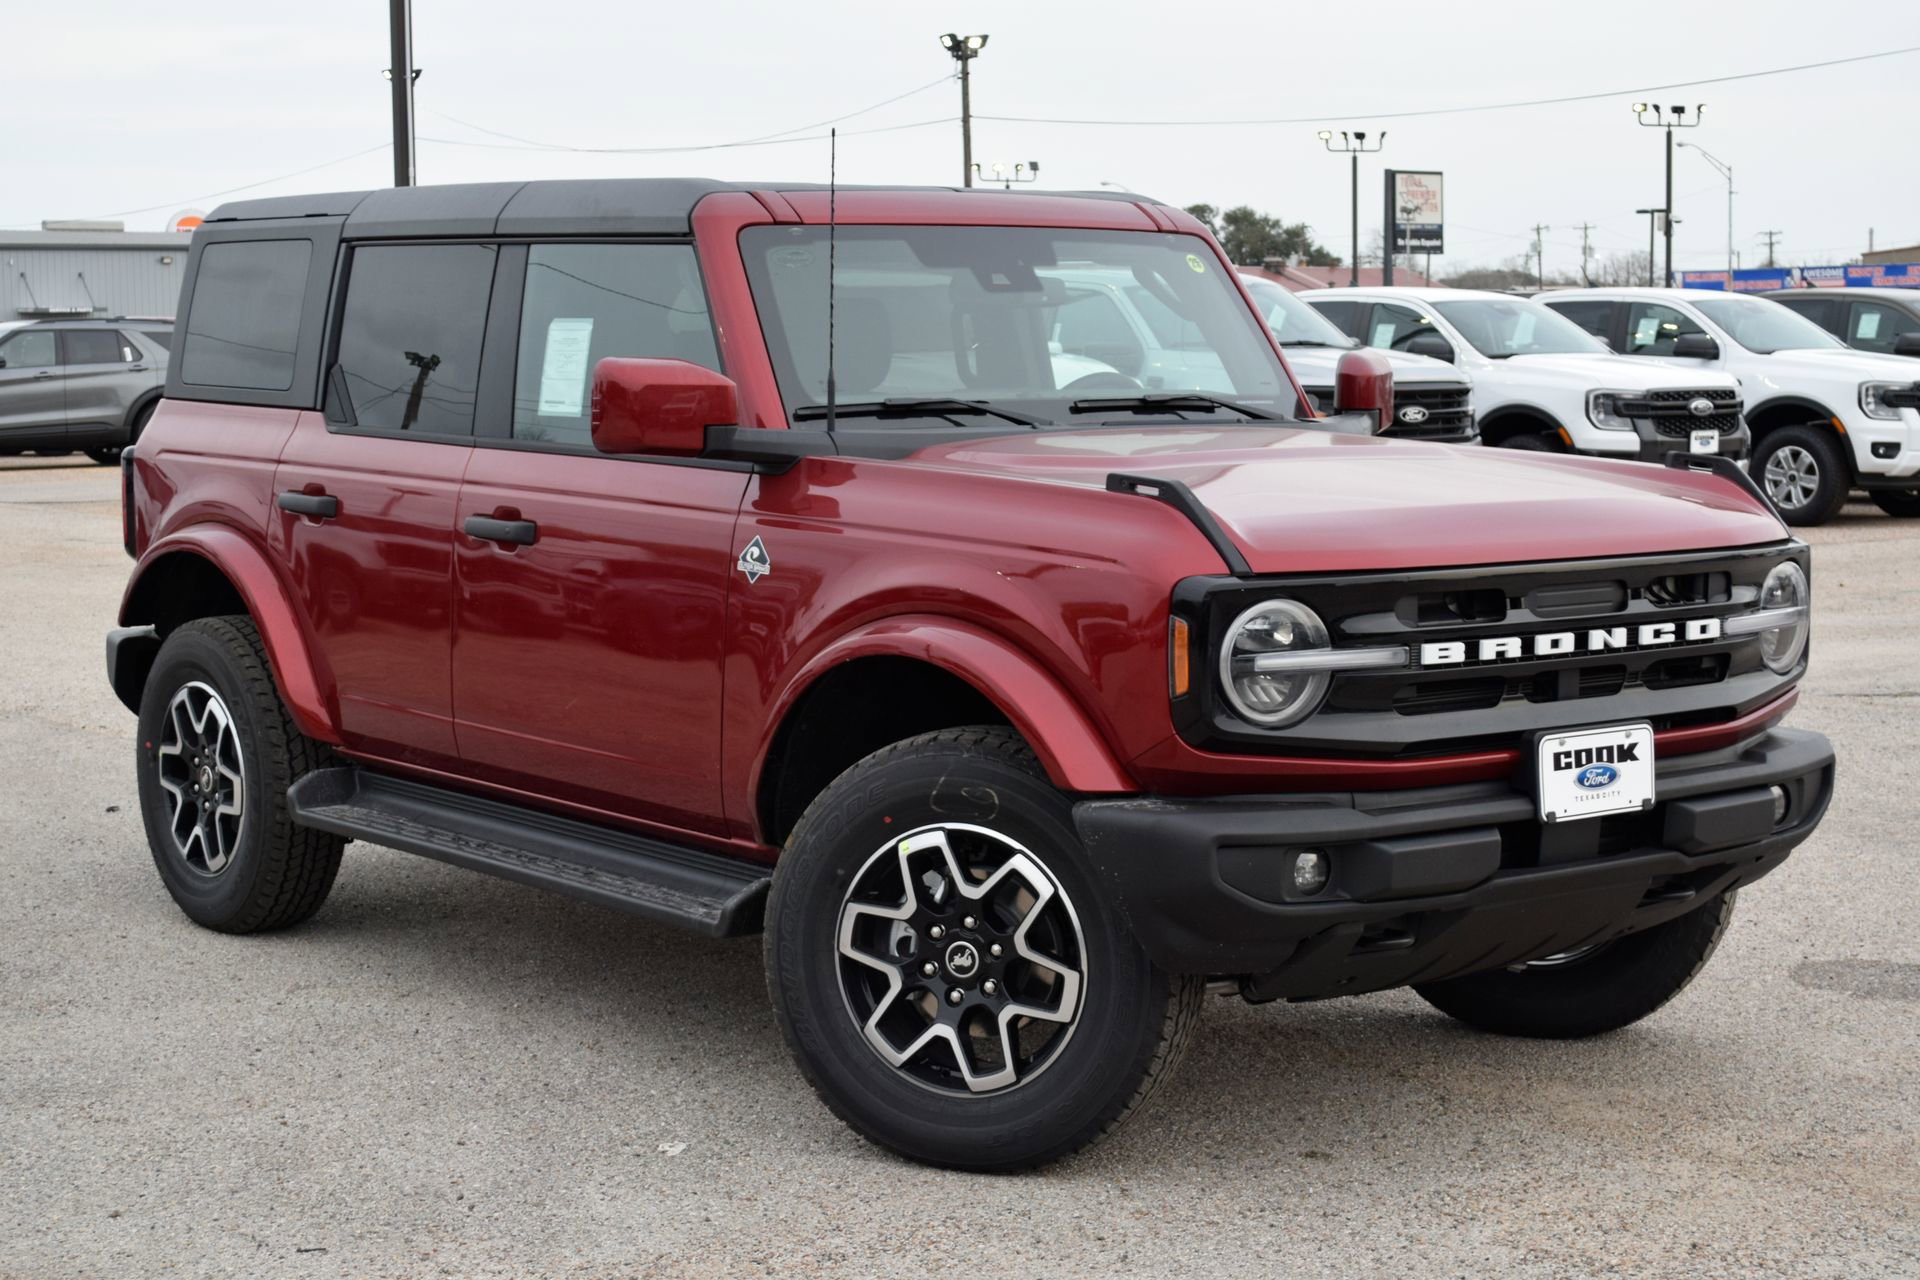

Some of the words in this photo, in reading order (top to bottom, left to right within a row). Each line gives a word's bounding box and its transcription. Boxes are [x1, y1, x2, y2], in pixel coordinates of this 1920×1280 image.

[1420, 618, 1721, 665] BRONCO
[1553, 742, 1640, 771] COOK
[1583, 767, 1611, 786] Ford
